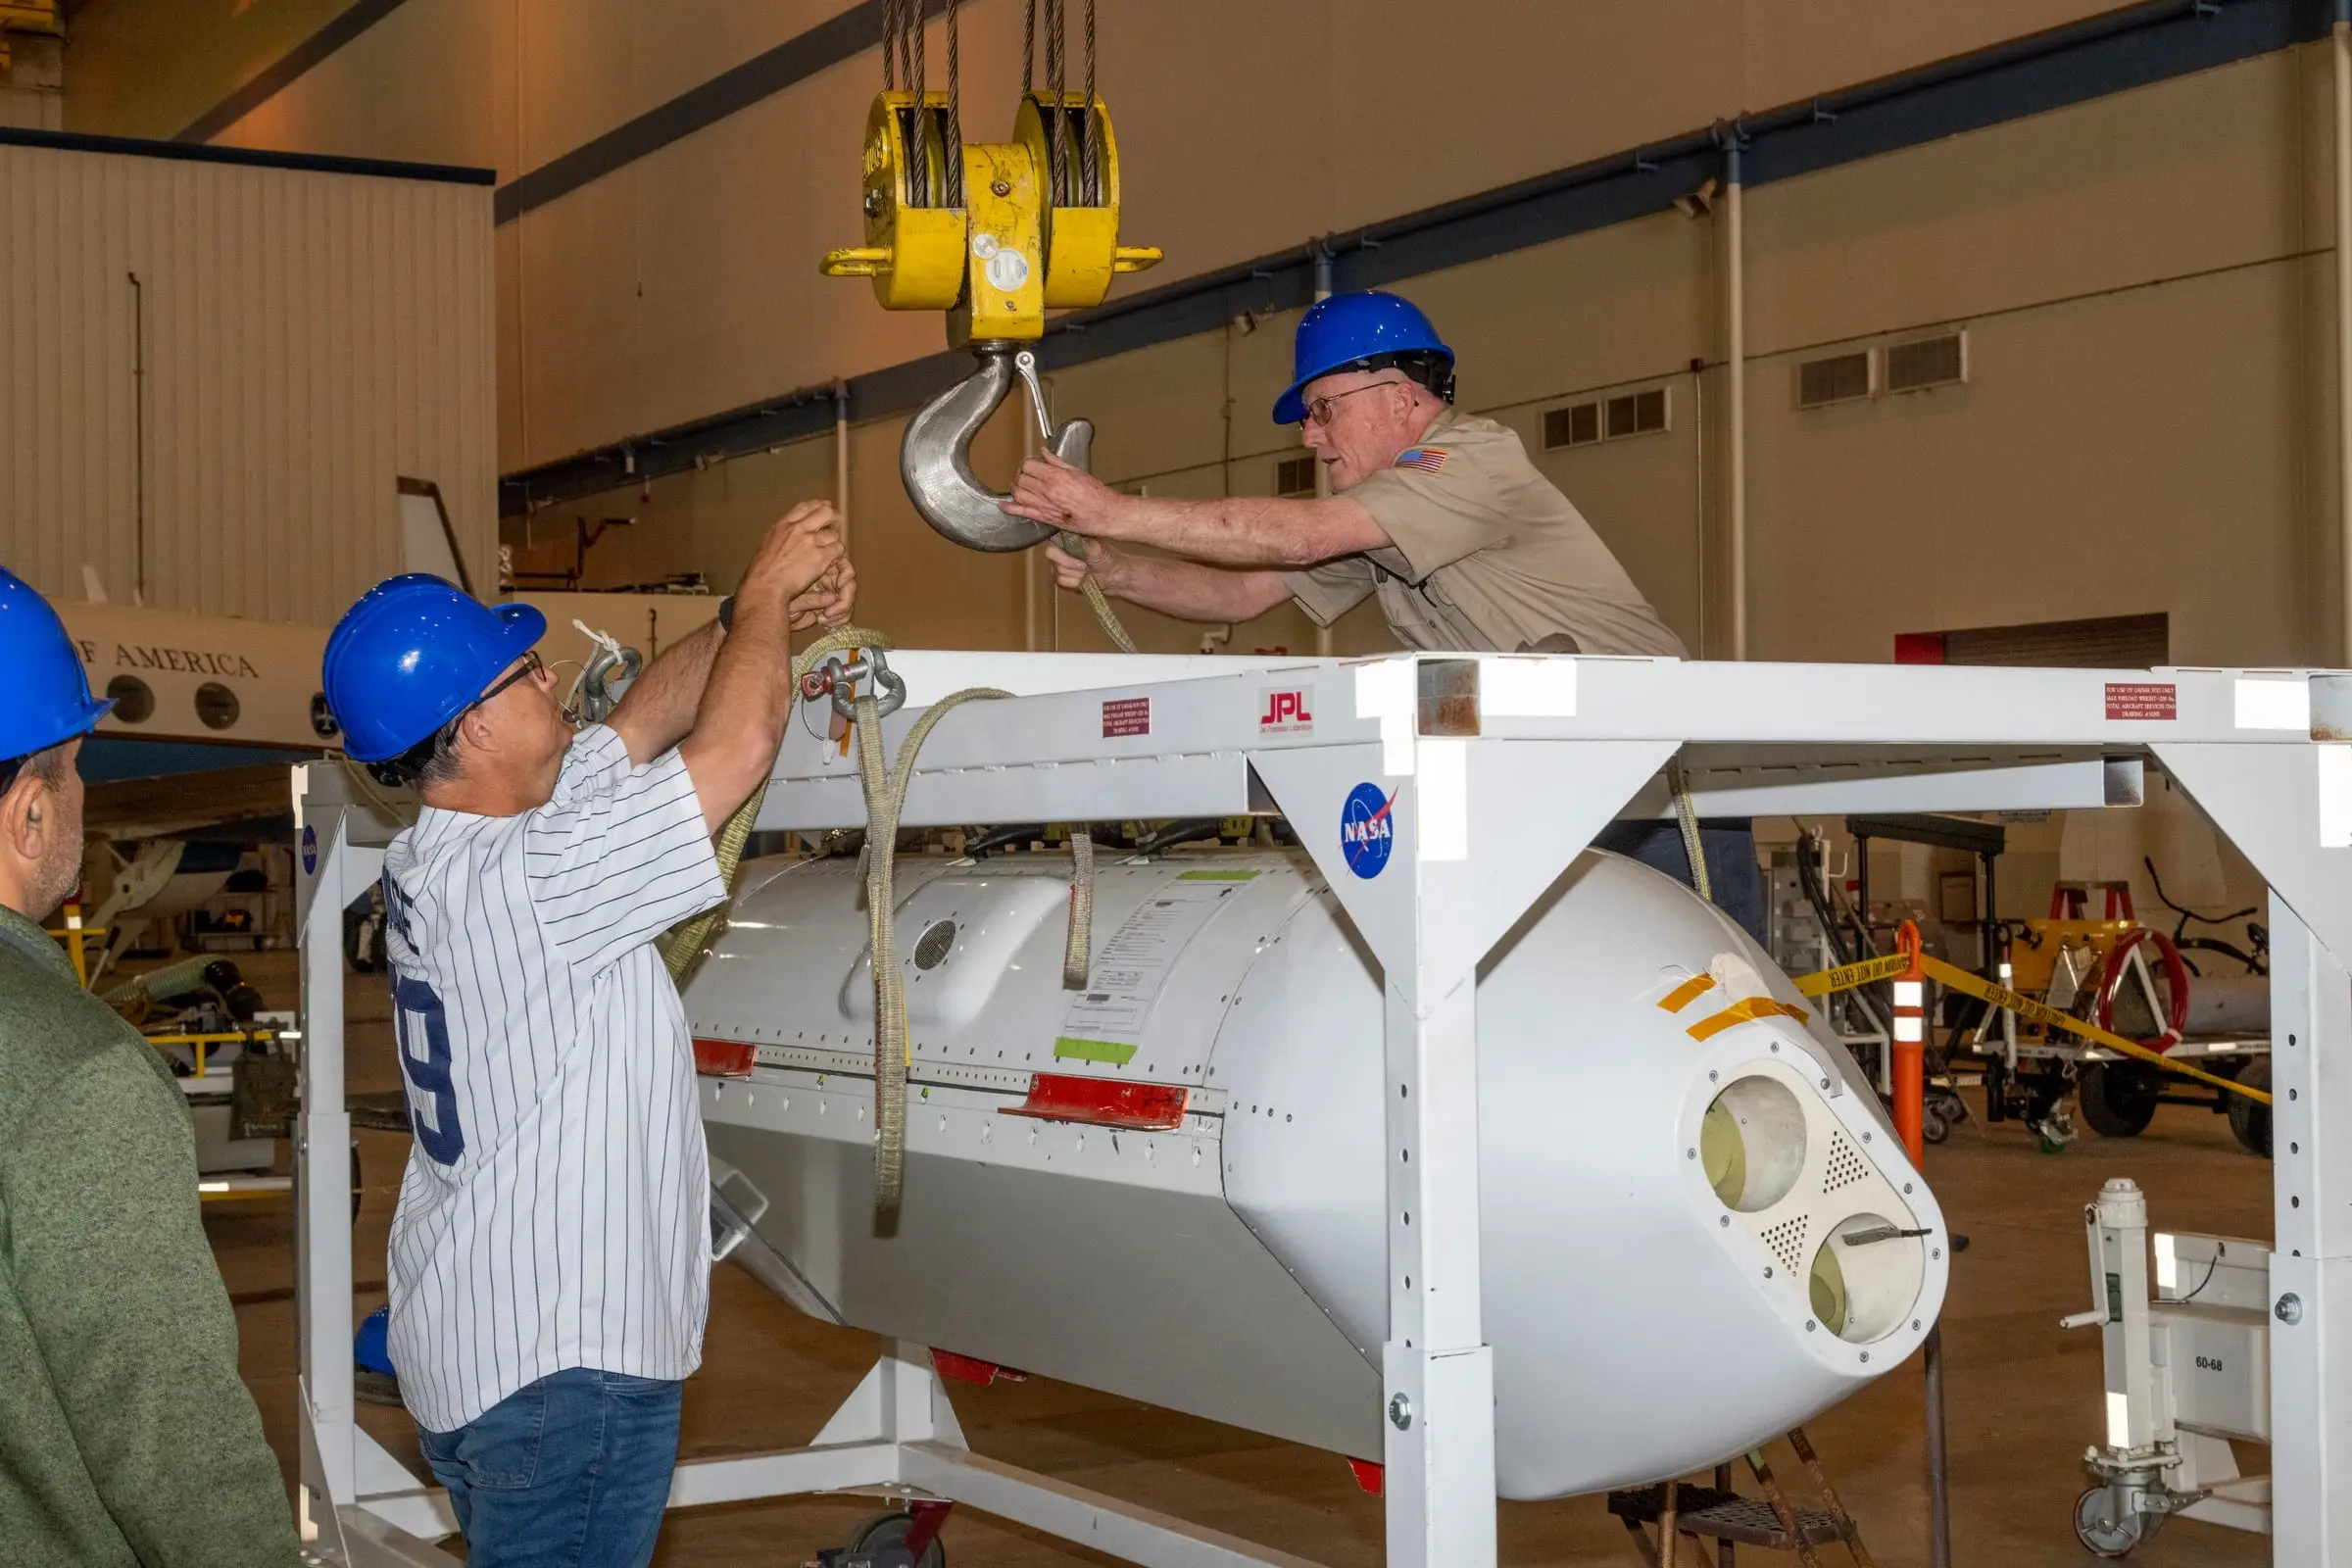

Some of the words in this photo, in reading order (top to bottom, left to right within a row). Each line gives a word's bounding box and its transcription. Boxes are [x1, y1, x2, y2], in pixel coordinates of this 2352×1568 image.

[74, 640, 96, 664] F
[115, 643, 261, 679] AMERICA
[1261, 691, 1312, 724] JPL
[1345, 818, 1392, 843] NASA
[1828, 968, 1855, 988] ENTER
[1855, 964, 1871, 981] NOT
[1872, 960, 1883, 977] DO
[2195, 1355, 2223, 1372] 60-68
